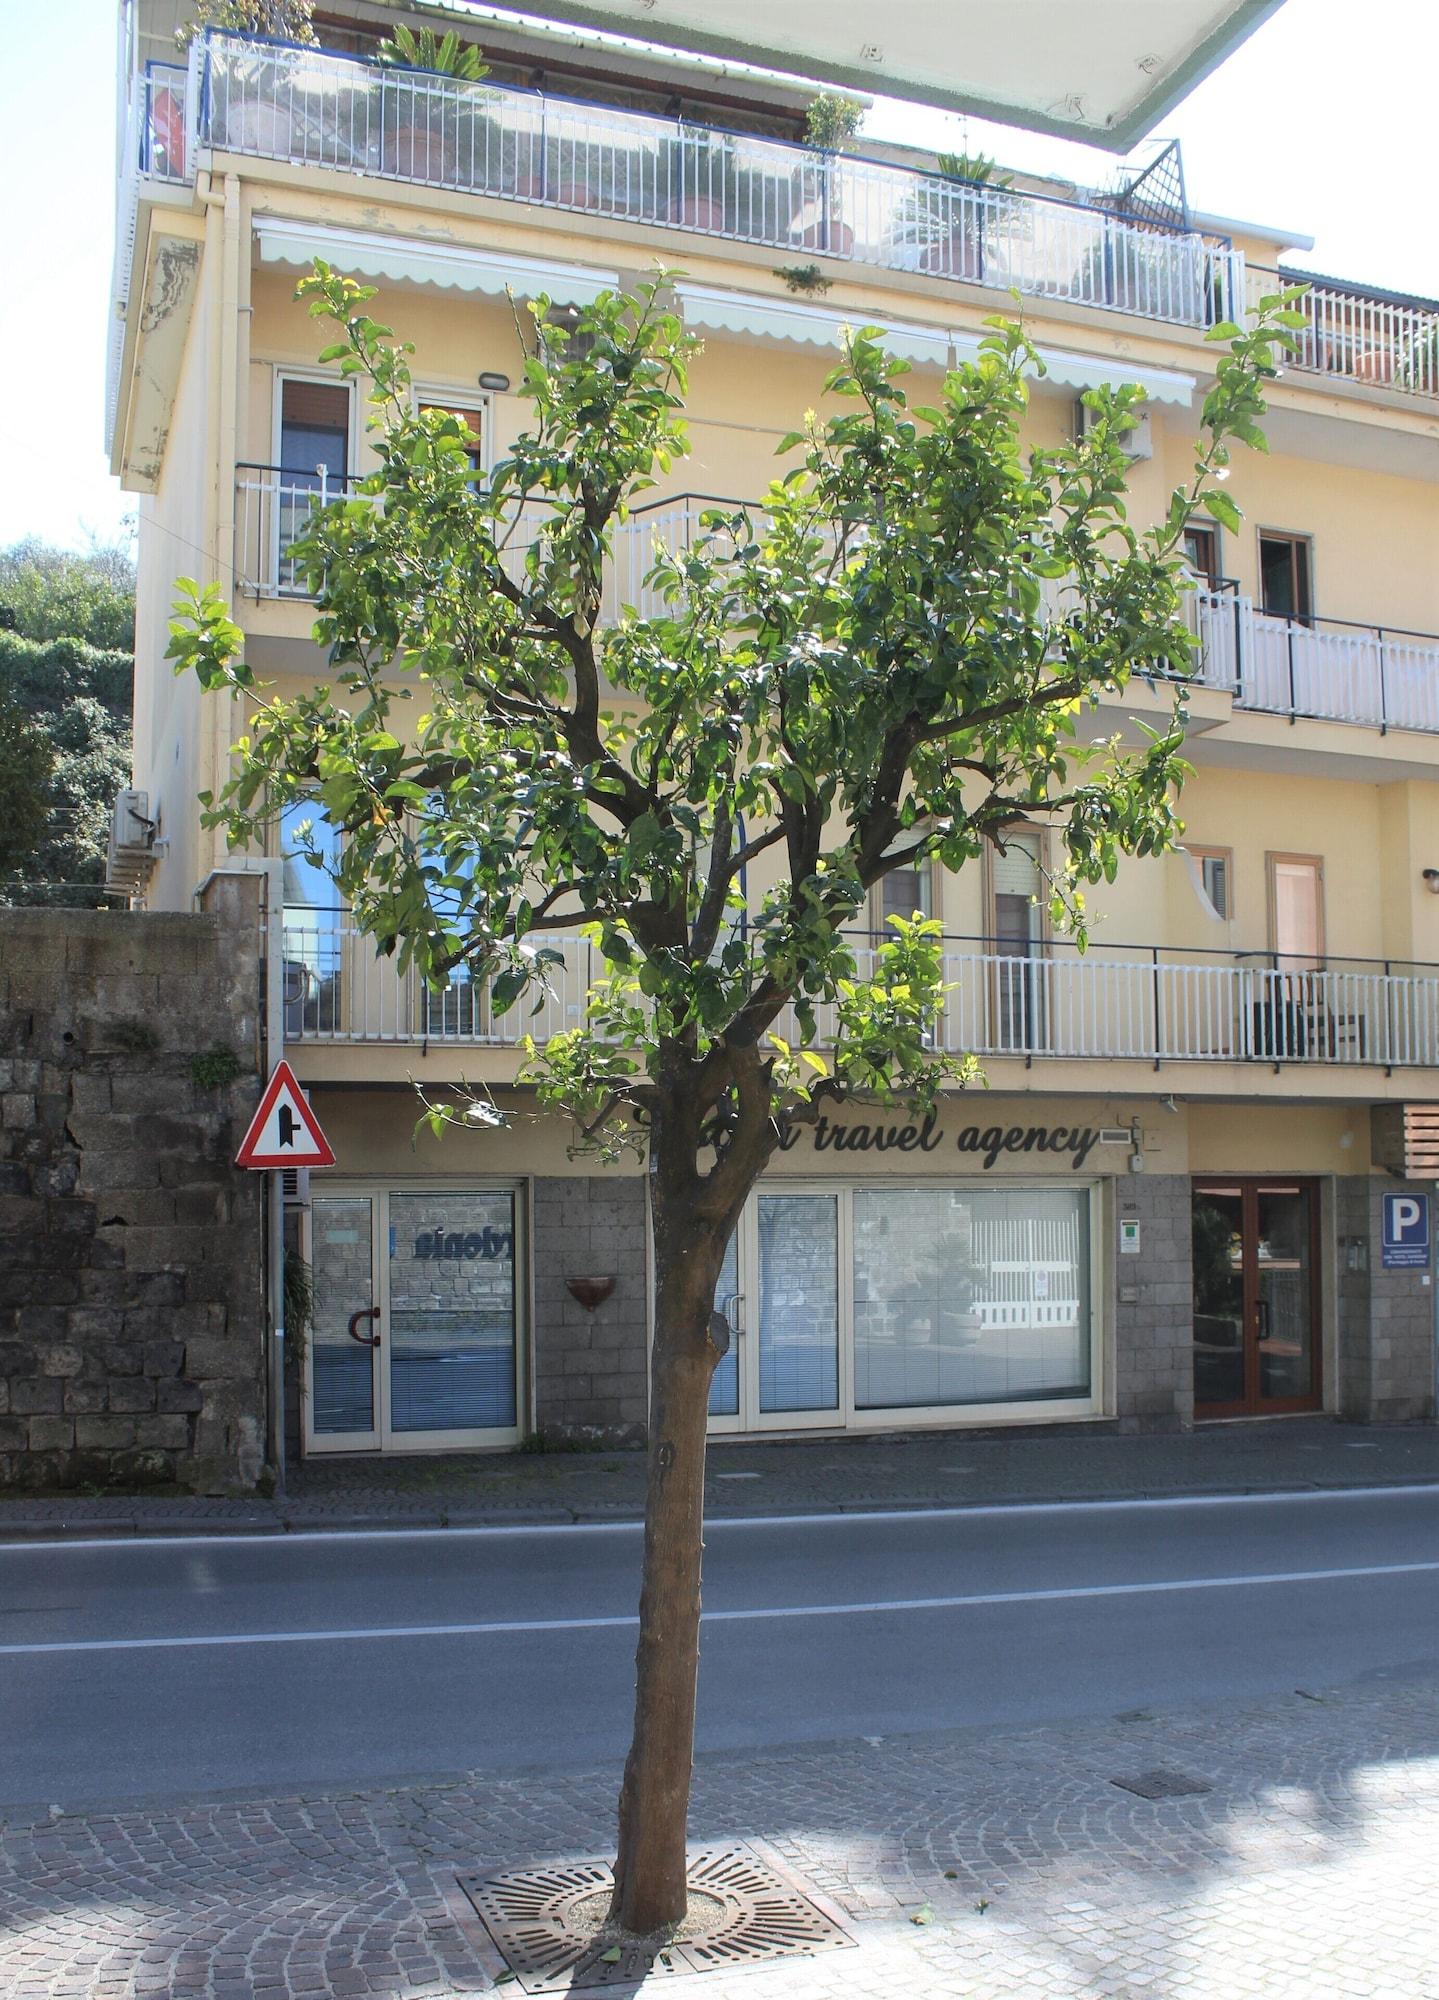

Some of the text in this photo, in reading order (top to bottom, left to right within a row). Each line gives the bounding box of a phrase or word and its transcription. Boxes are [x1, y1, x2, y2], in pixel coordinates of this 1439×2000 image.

[813, 1104, 944, 1151] travel
[957, 1125, 1101, 1169] agency
[1392, 1198, 1421, 1241] P
